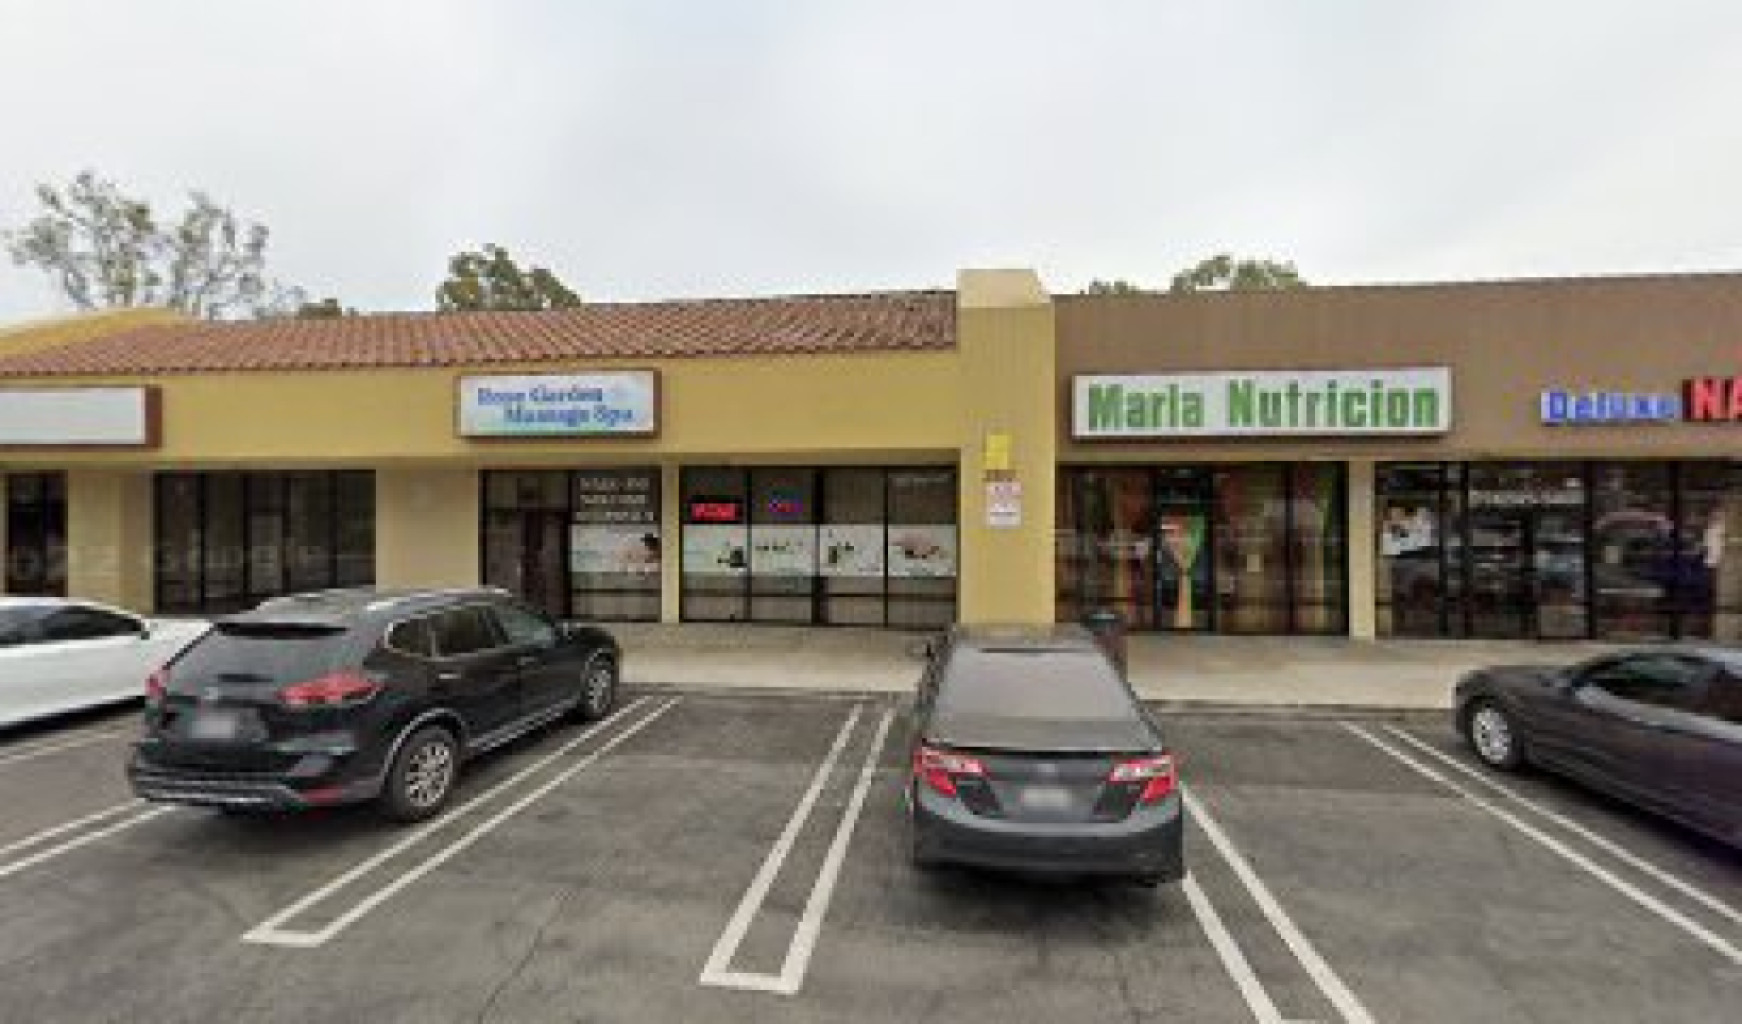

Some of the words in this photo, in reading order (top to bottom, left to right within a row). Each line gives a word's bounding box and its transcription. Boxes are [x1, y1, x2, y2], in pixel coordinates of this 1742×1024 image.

[528, 385, 603, 405] Garden
[1228, 379, 1441, 429] Nutricion
[1540, 391, 1675, 421] Deluxe
[504, 405, 590, 428] Massage
[594, 405, 634, 428] Spa
